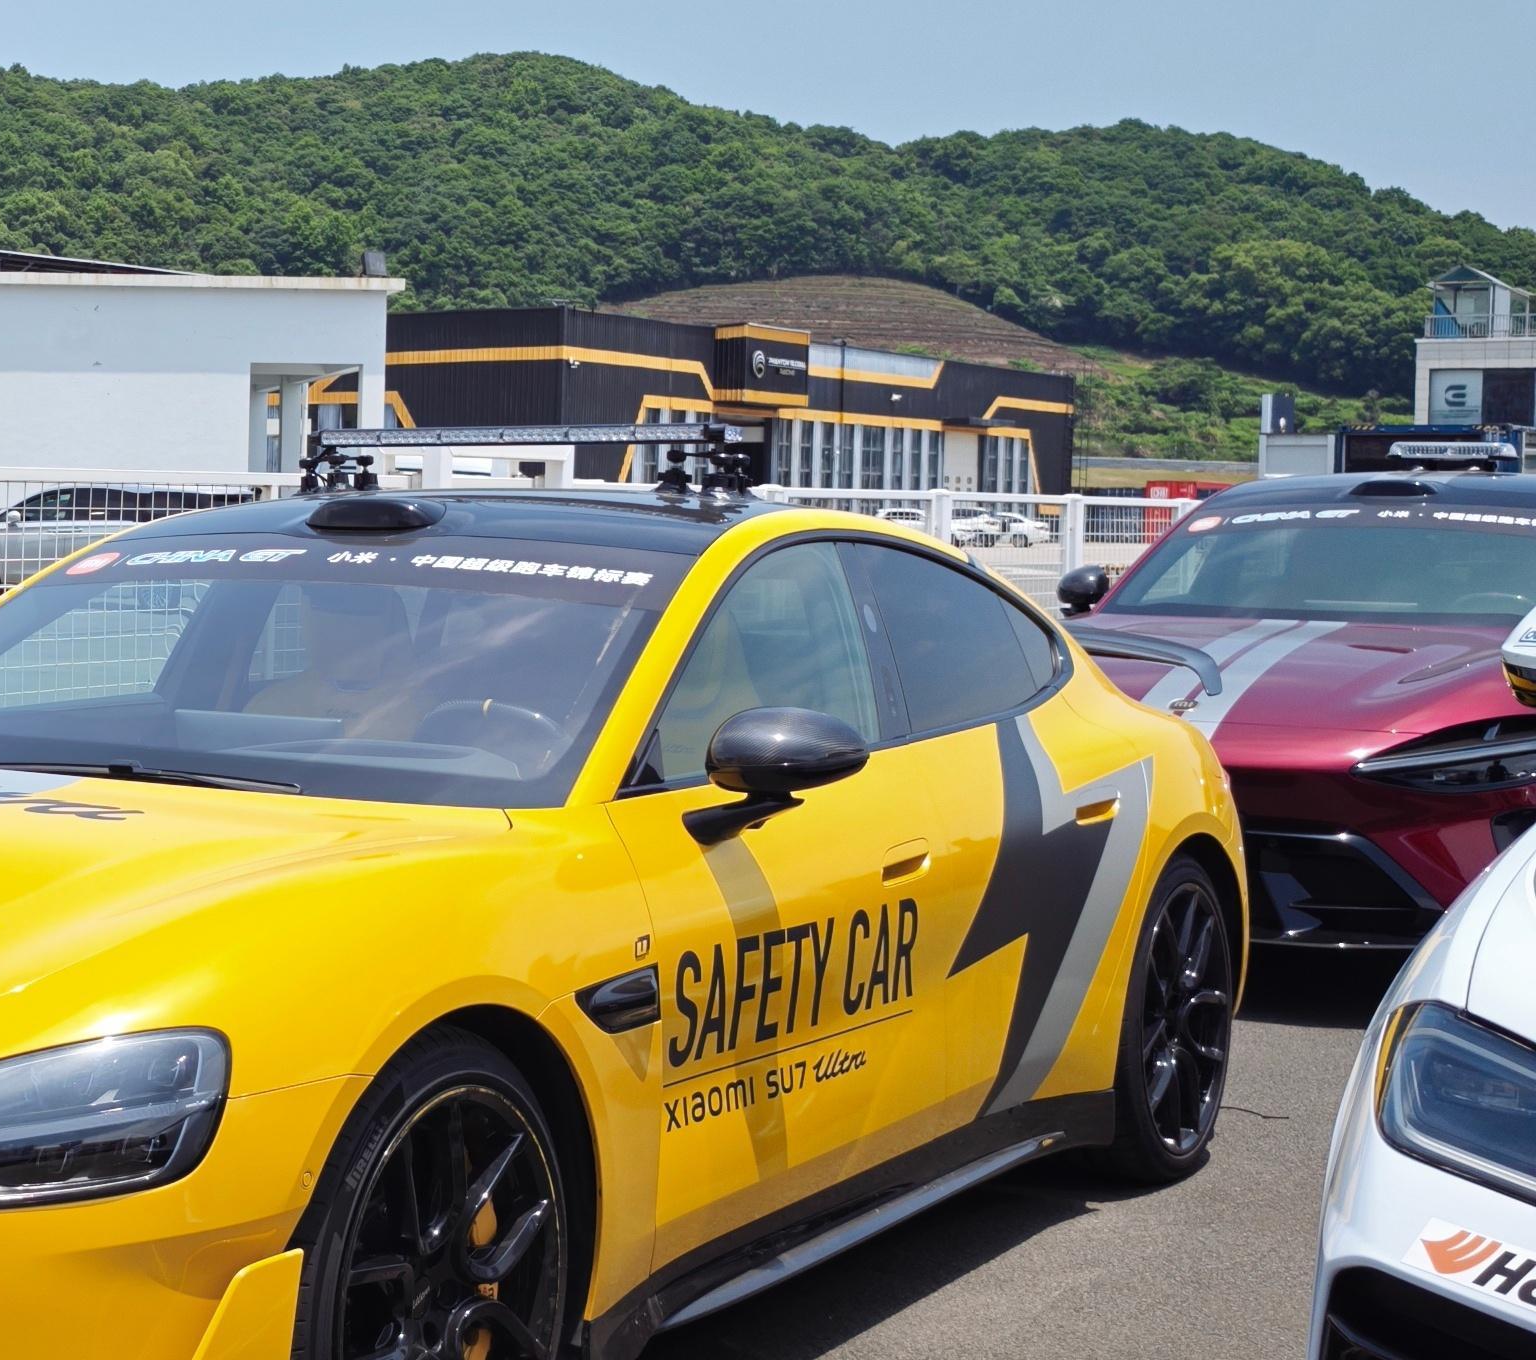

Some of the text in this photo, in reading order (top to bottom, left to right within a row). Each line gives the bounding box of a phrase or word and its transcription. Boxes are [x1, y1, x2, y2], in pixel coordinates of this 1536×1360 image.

[668, 897, 919, 1067] SAFETY CAR
[664, 1049, 867, 1133] xiaomi SU7 Ultra
